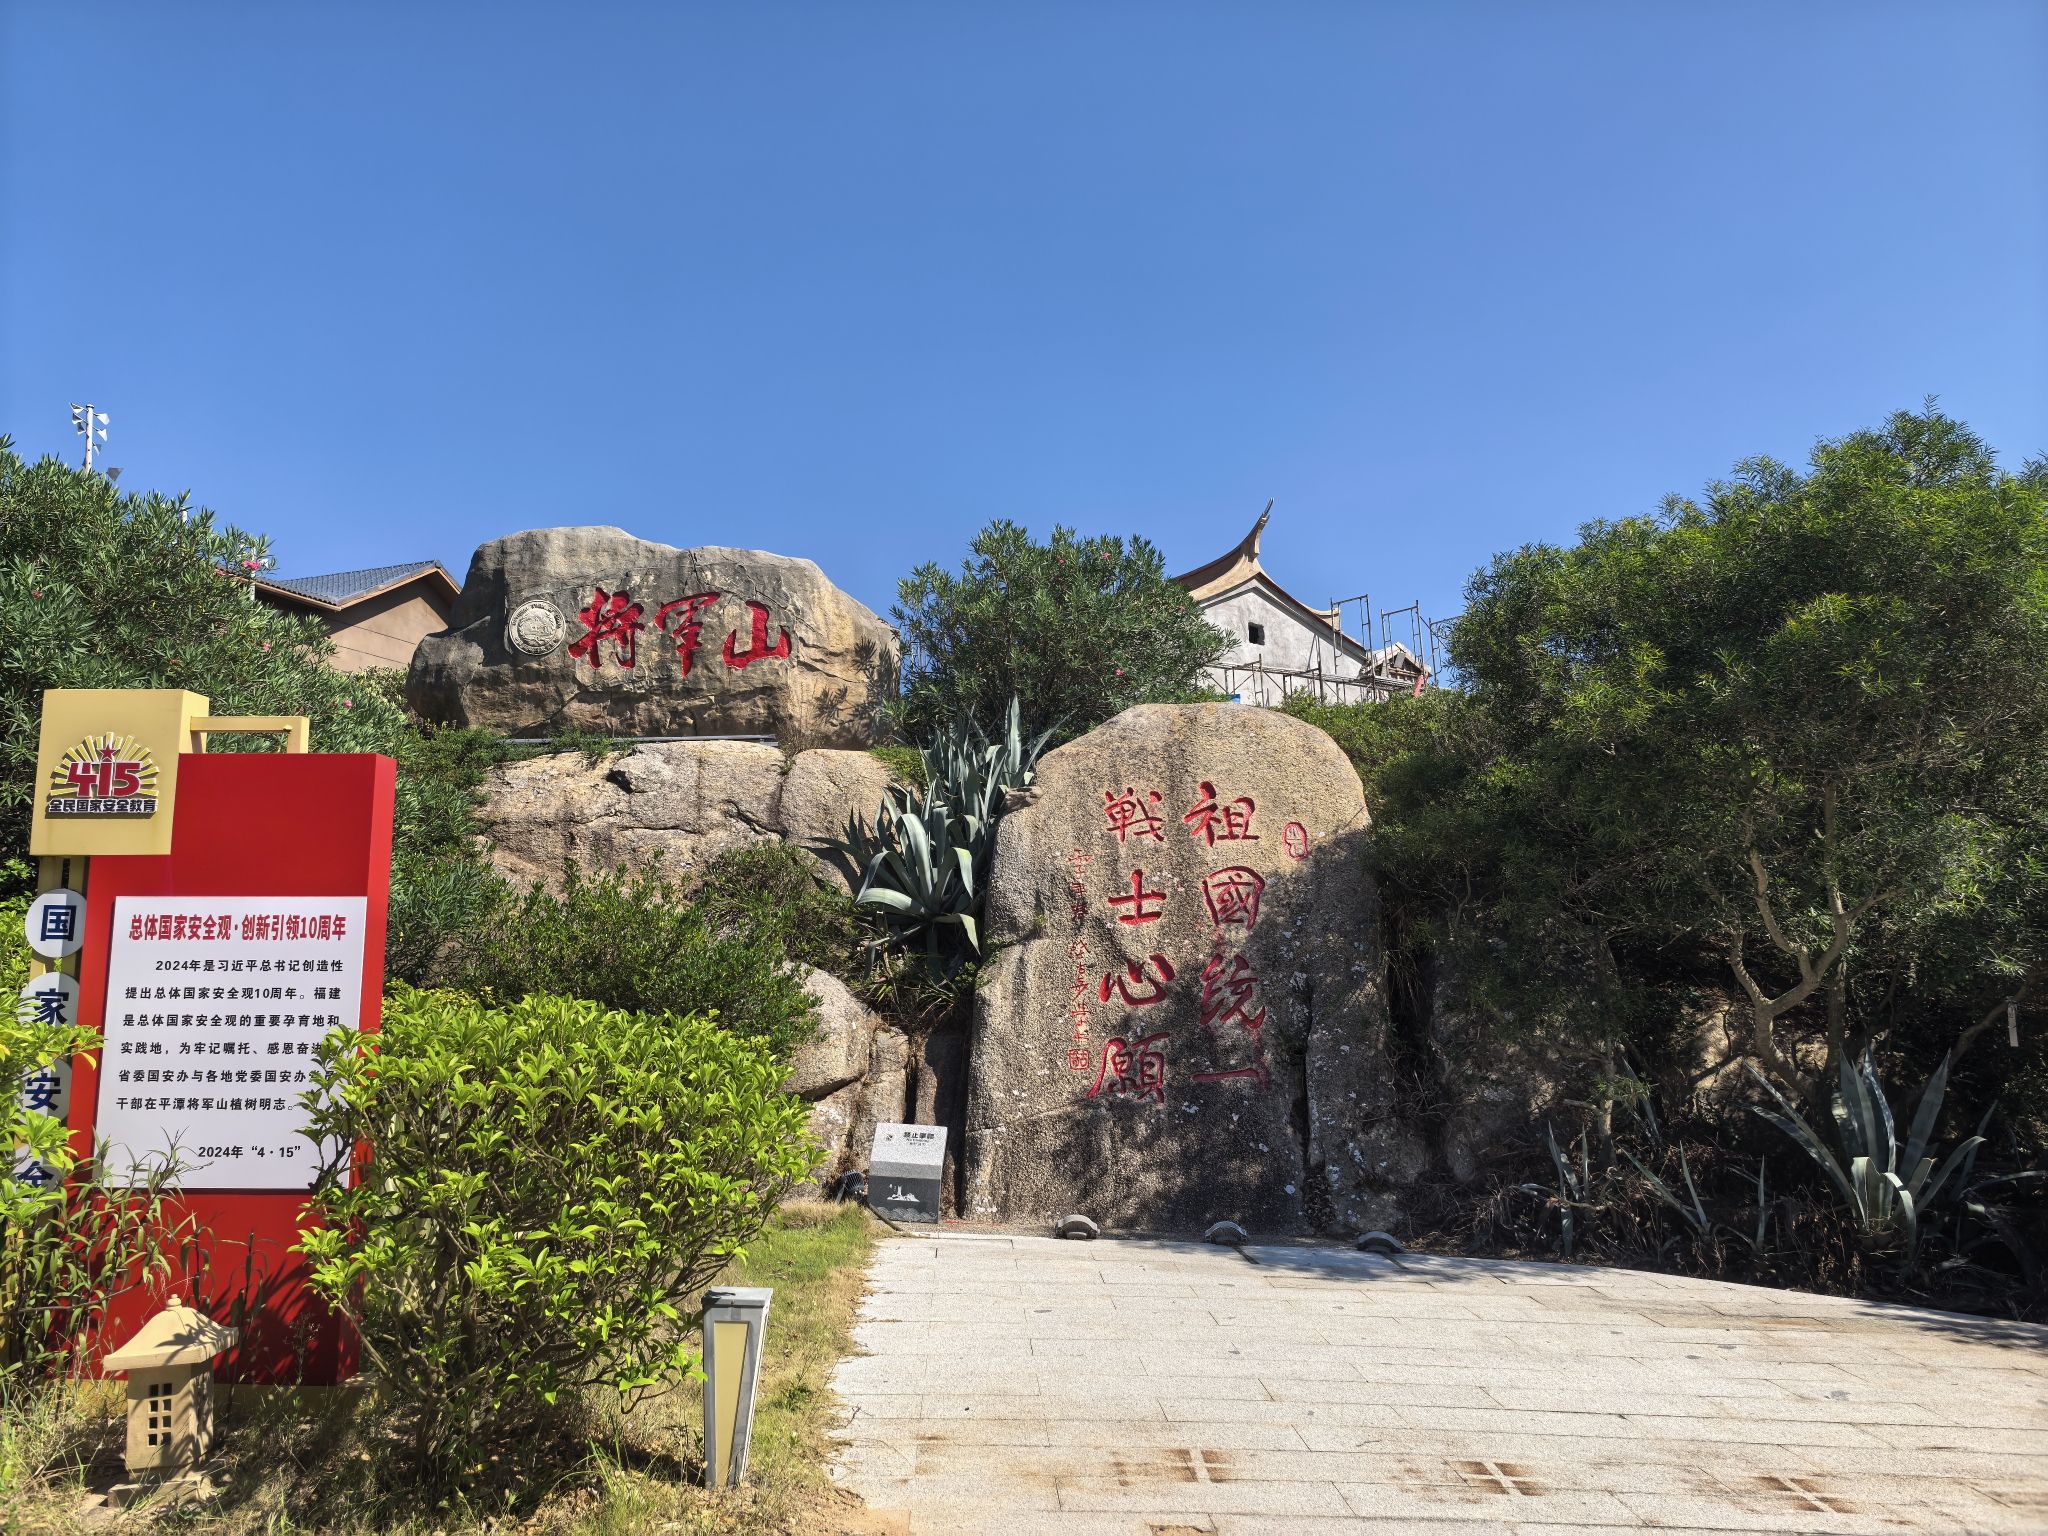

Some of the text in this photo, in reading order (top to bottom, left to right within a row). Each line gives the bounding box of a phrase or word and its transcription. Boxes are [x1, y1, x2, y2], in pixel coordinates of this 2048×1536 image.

[66, 761, 142, 798] 415
[48, 798, 158, 814] 全民国家安全教育
[128, 913, 348, 942] 总体国家安全观·创新引领10周年
[155, 959, 344, 973] 2024年是习近平总书记创造性
[125, 986, 342, 1000] 提出总体国家安全观10周年。福建
[122, 1013, 340, 1027] 是总体国家安全观的重要孕育地和
[115, 1097, 294, 1112] 干部在平潭将军山植树明志。
